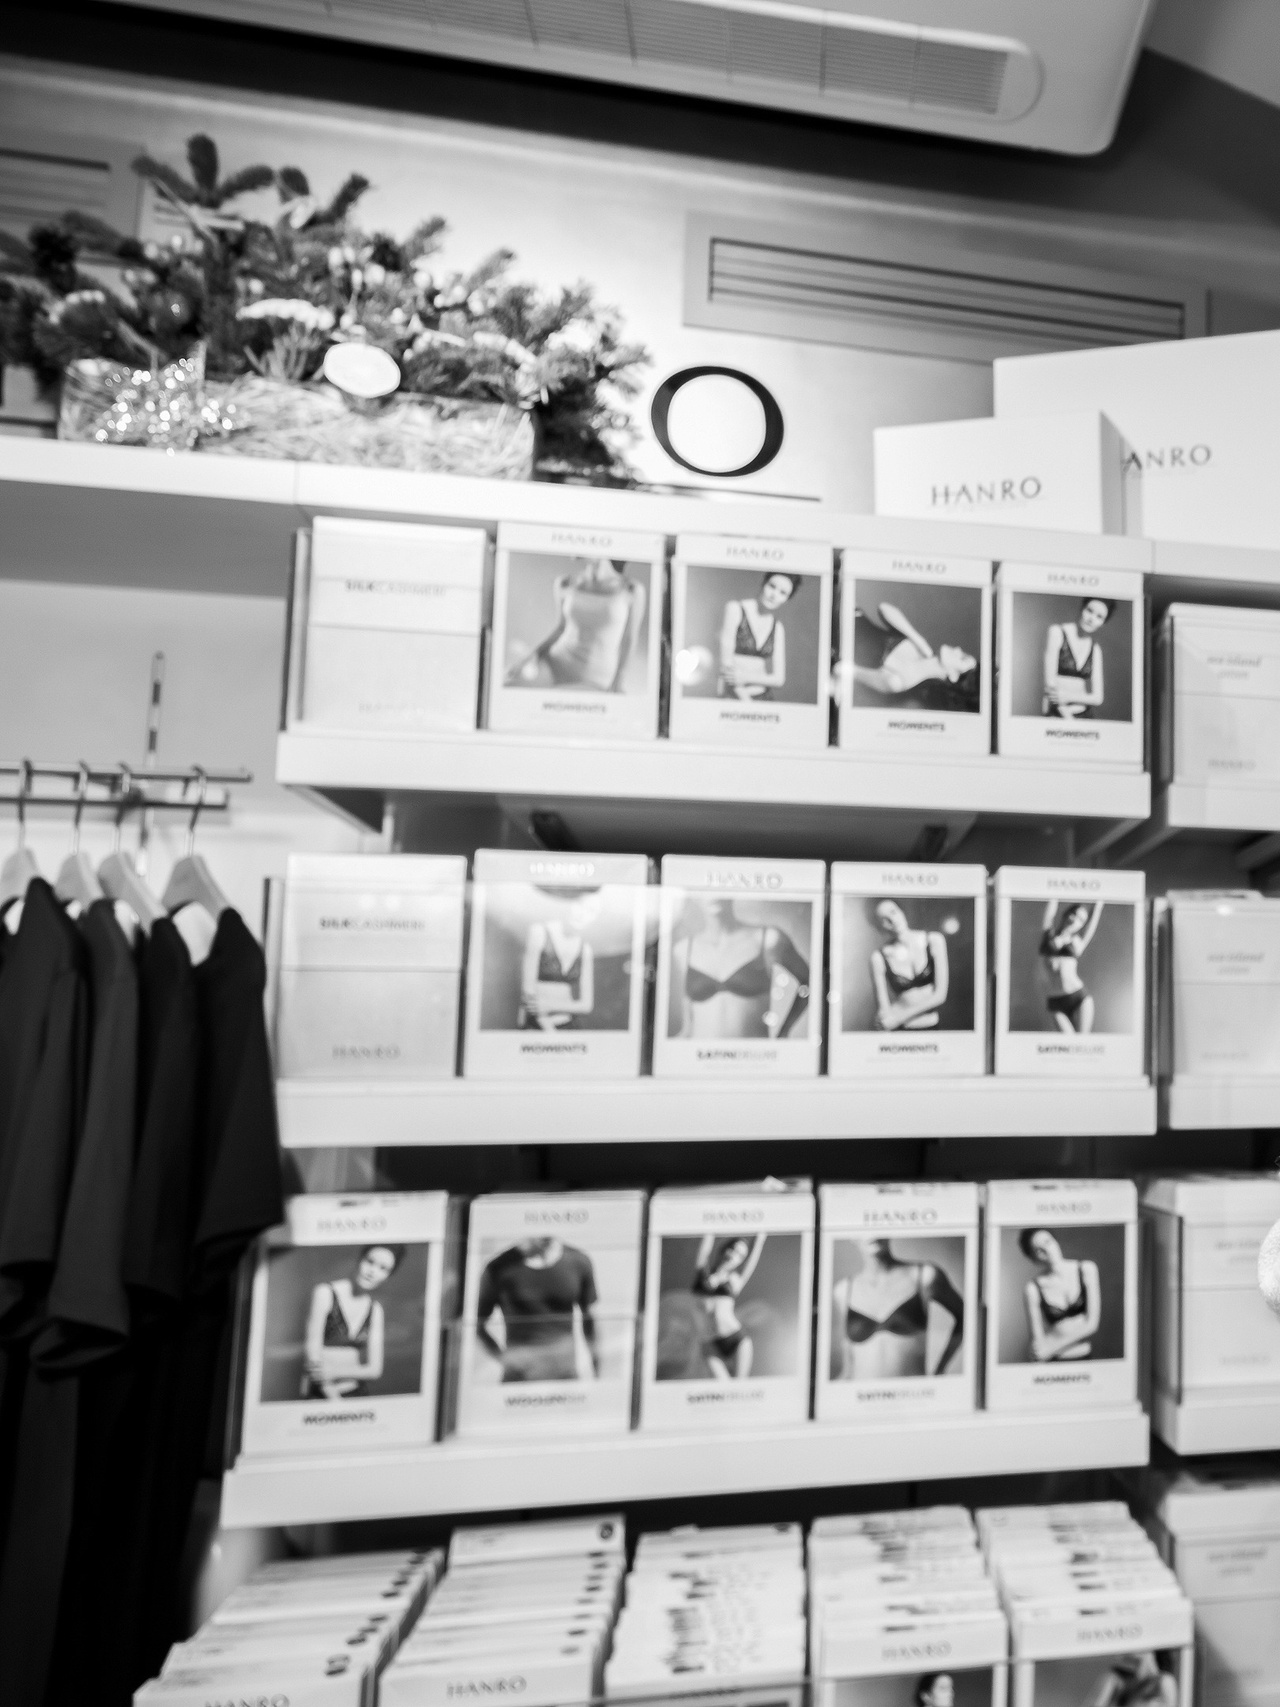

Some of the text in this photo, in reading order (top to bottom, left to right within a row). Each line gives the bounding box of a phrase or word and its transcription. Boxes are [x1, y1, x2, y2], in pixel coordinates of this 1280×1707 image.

[651, 365, 784, 477] O
[1120, 444, 1211, 474] ANRO
[932, 476, 1042, 506] HANRO
[726, 545, 784, 561] HANRO
[892, 559, 946, 574] HANRO
[1047, 572, 1099, 586] HANRO
[542, 702, 607, 714] MOMENTS
[720, 711, 781, 724] MOMENTS
[888, 720, 946, 733] MOMENTS
[1045, 728, 1100, 741] MOMENTS
[704, 871, 784, 890] HANRO
[881, 872, 939, 887] HANRO
[1047, 877, 1102, 891] HANRO
[520, 1043, 588, 1055] MOMENTS
[878, 1042, 939, 1055] MOMENTS
[863, 1207, 938, 1226] HANRO
[303, 1411, 376, 1425] MOMENTS
[447, 1674, 527, 1699] HANRO
